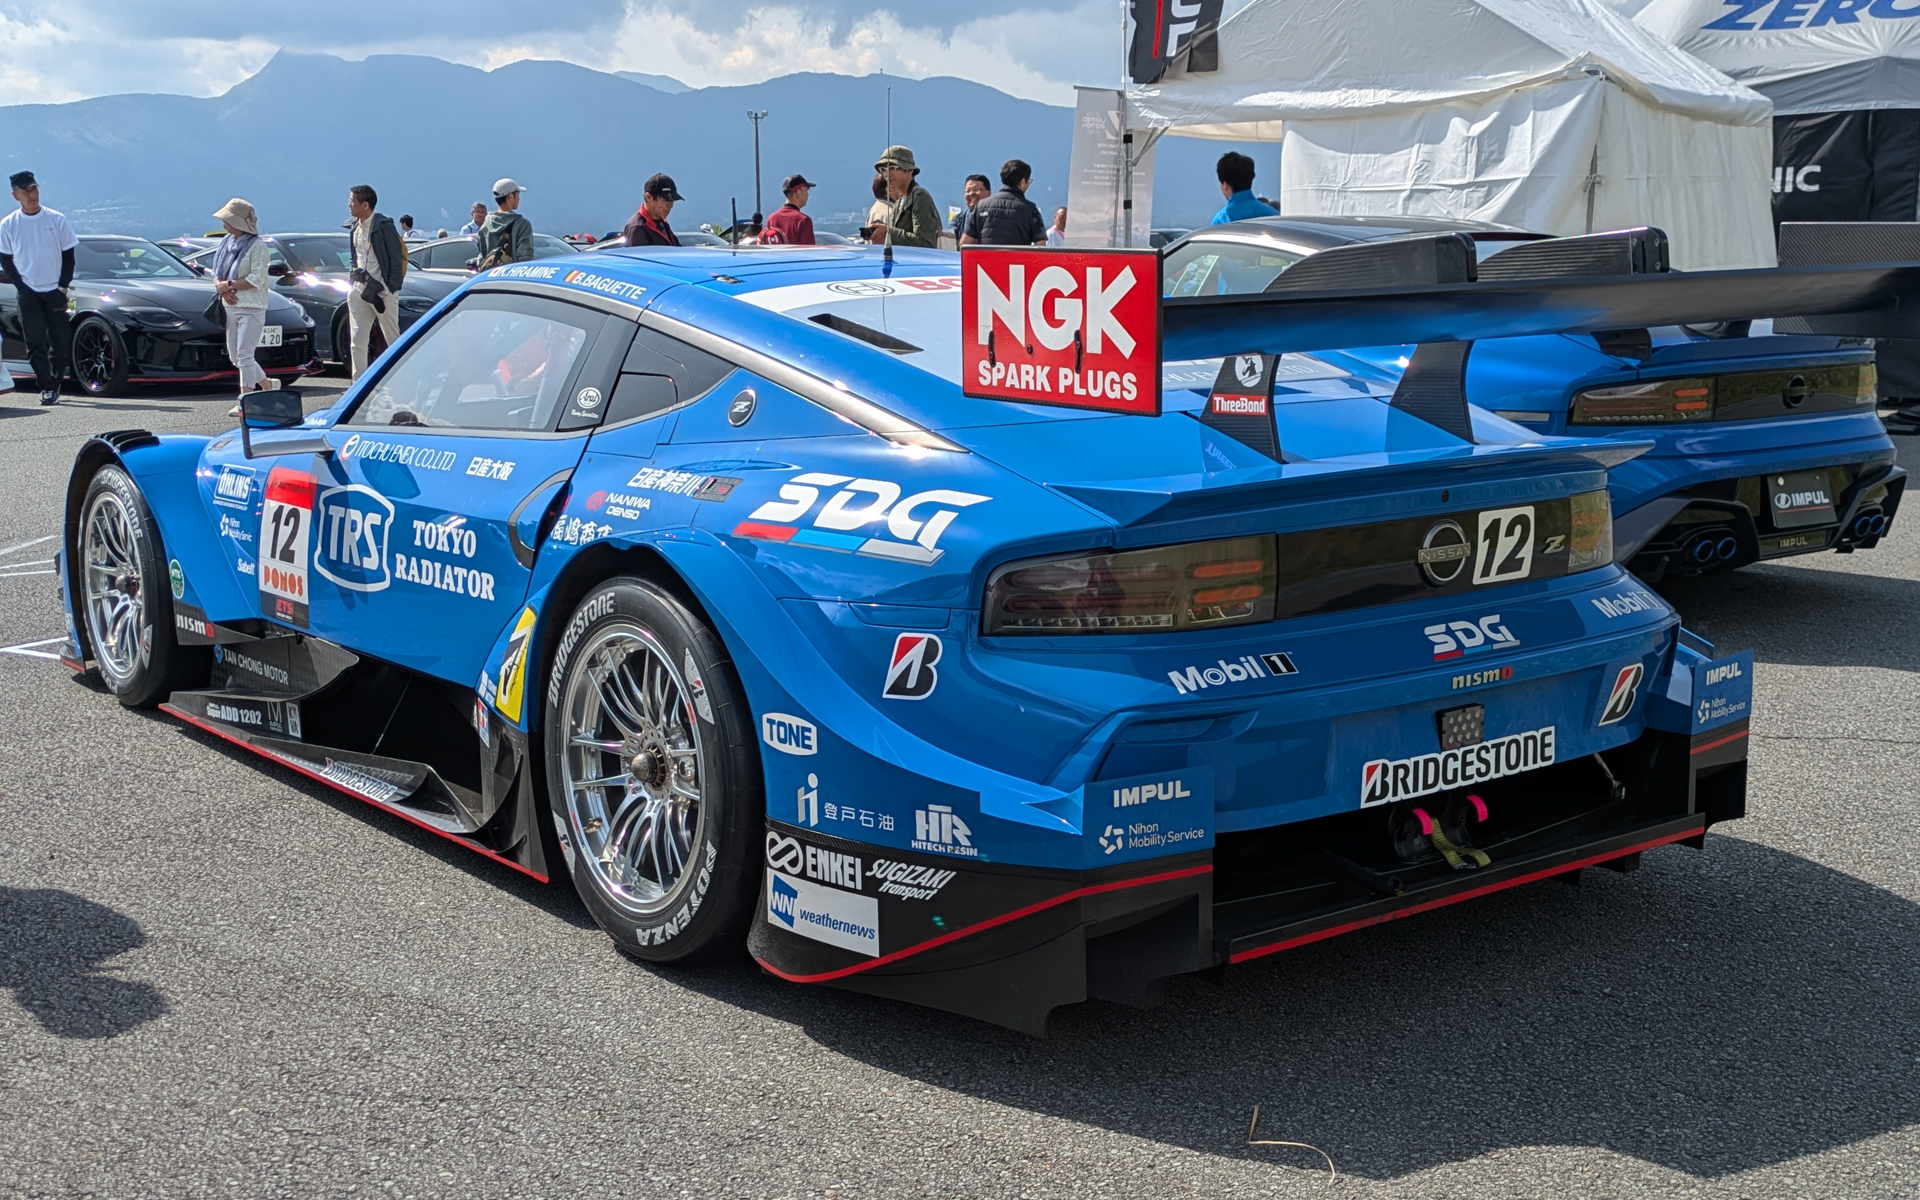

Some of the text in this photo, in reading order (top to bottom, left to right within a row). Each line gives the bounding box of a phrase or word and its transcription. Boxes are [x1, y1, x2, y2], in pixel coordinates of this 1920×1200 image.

[498, 265, 560, 279] K.HIRAMINE
[572, 272, 647, 300] B.BAGUETTE
[977, 264, 1137, 359] NGK
[978, 360, 1138, 401] SPARK PLUGS
[1213, 396, 1265, 413] ThreeBond
[354, 440, 395, 462] ITOCHU
[389, 445, 419, 466] ENEX
[218, 467, 251, 499] ÖHLINS
[465, 456, 517, 481] 日産大阪
[627, 467, 707, 497] 日産神奈川
[606, 492, 651, 511] NANIWA
[748, 472, 993, 552] SDG
[1791, 490, 1829, 506] IMPUL
[606, 506, 640, 520] DENSO
[270, 505, 300, 564] 12
[328, 504, 382, 570] TRS
[413, 520, 477, 558] TOKYO
[1479, 513, 1531, 579] 12
[1780, 537, 1808, 548] IMPUL
[1420, 543, 1470, 561] NISSAN
[264, 565, 304, 597] PONOS
[395, 553, 495, 601] RADIATOR
[277, 600, 293, 616] ETS
[1424, 614, 1516, 654] SDG
[549, 592, 616, 709] BRIDGESTONE
[223, 648, 288, 685] TAN CHONG MOTOR
[1168, 655, 1266, 695] Mobil
[1452, 666, 1514, 690] nismo
[1706, 662, 1742, 685] IMPUL
[221, 705, 239, 722] ADD
[239, 709, 262, 725] 1202
[1711, 698, 1727, 709] Nihon
[766, 717, 813, 750] TONE
[1364, 729, 1554, 804] BRIDGESTONE
[1113, 780, 1190, 808] IMPUL
[824, 802, 894, 831] 登戸石油
[1128, 823, 1158, 836] Nihon
[911, 840, 978, 857] HITECH RESIN
[1128, 828, 1204, 849] Mobility Service
[806, 845, 862, 890] ENKEI
[865, 859, 957, 888] SUGIZAKI
[636, 839, 718, 946] POTENZA
[878, 881, 938, 901] transport
[800, 908, 876, 940] weathernews
